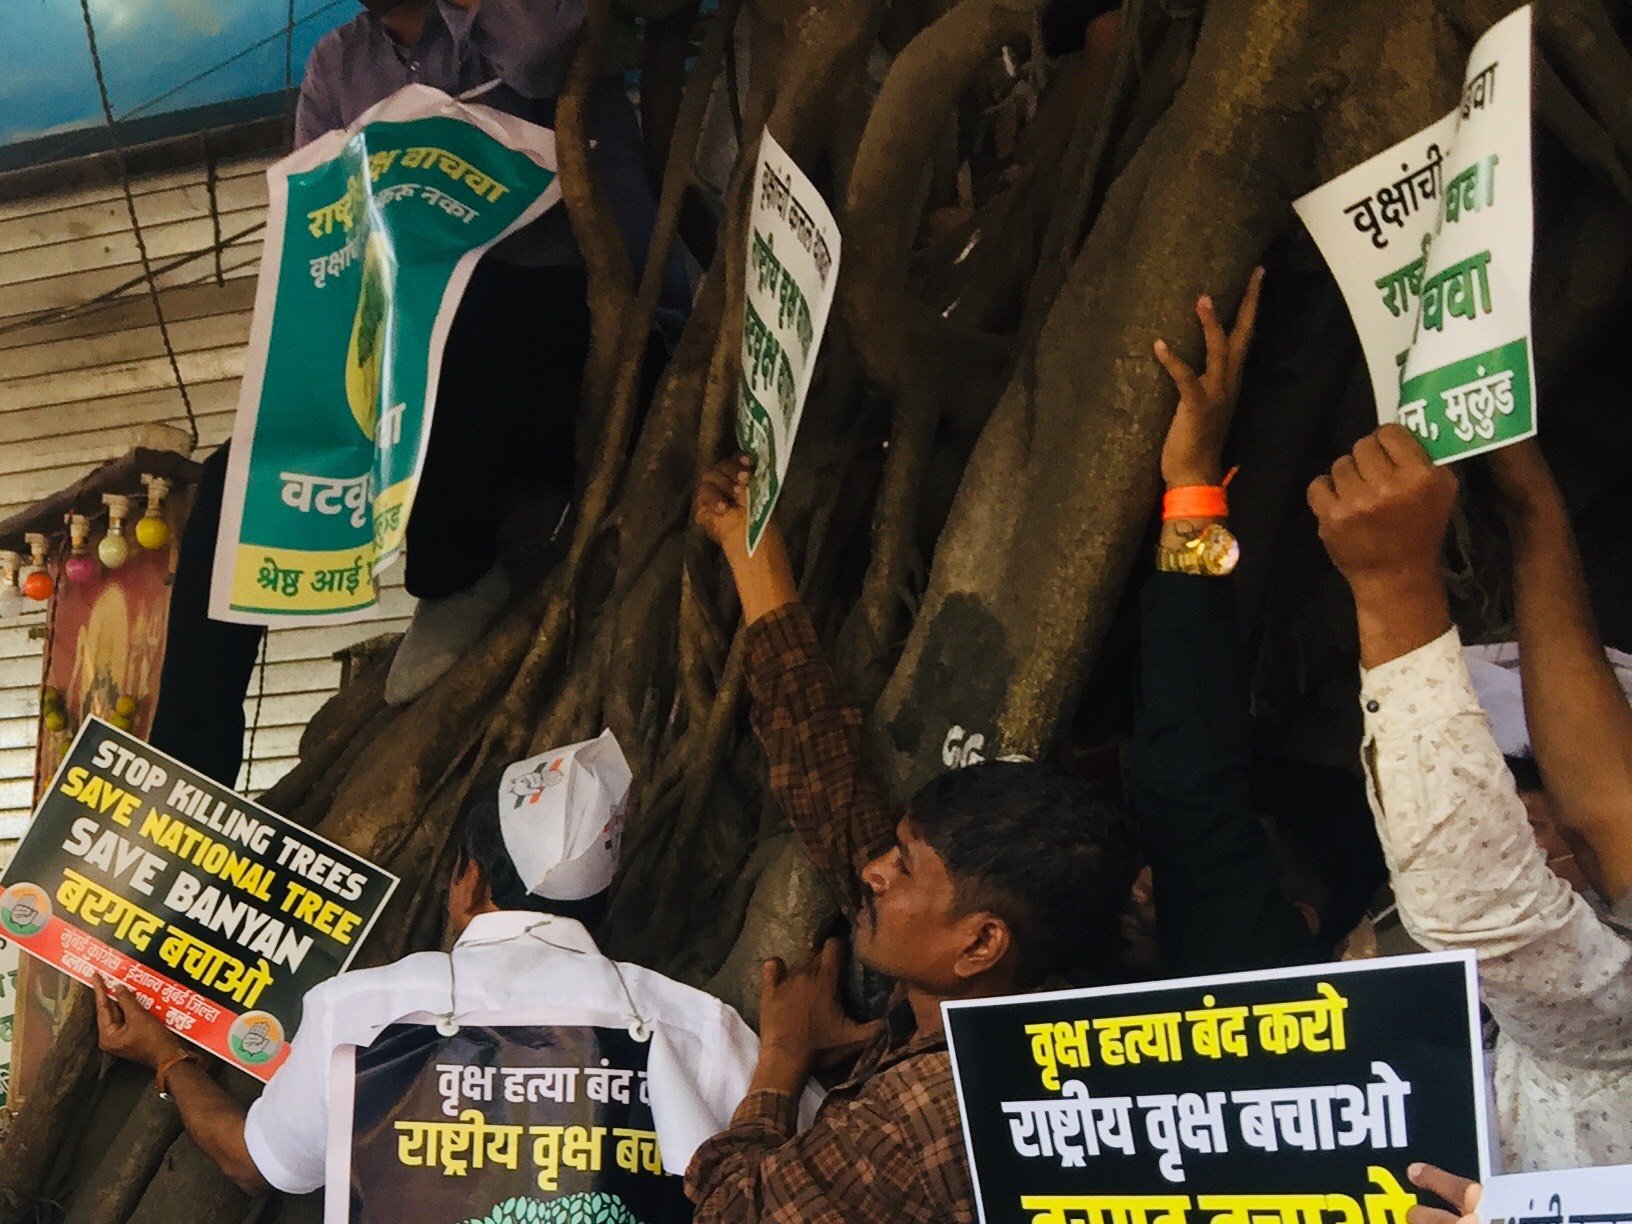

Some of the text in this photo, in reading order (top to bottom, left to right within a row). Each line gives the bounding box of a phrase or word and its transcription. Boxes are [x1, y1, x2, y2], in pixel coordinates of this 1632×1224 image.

[400, 147, 509, 203] वाचवा
[421, 186, 480, 224] नका
[1440, 365, 1515, 442] मुलुंड
[257, 558, 303, 596] श्रेष्ठ
[310, 556, 360, 596] आई
[60, 767, 362, 944] SAVE NATIONAL TREE
[92, 740, 367, 902] STOP KILLING TREES
[56, 869, 273, 1008] बरगद बचाओ
[62, 817, 315, 976] SAVE BANYAN
[1024, 982, 1348, 1091] वृक्ष हत्या बंद करो
[436, 1063, 496, 1115] वृक्ष
[503, 1067, 576, 1105] हत्या
[586, 1057, 634, 1104] बंद
[1000, 1060, 1411, 1182] राष्ट्रीय वृक्ष बचाओ
[394, 1109, 664, 1190] राष्ट्रीय वृक्ष बच
